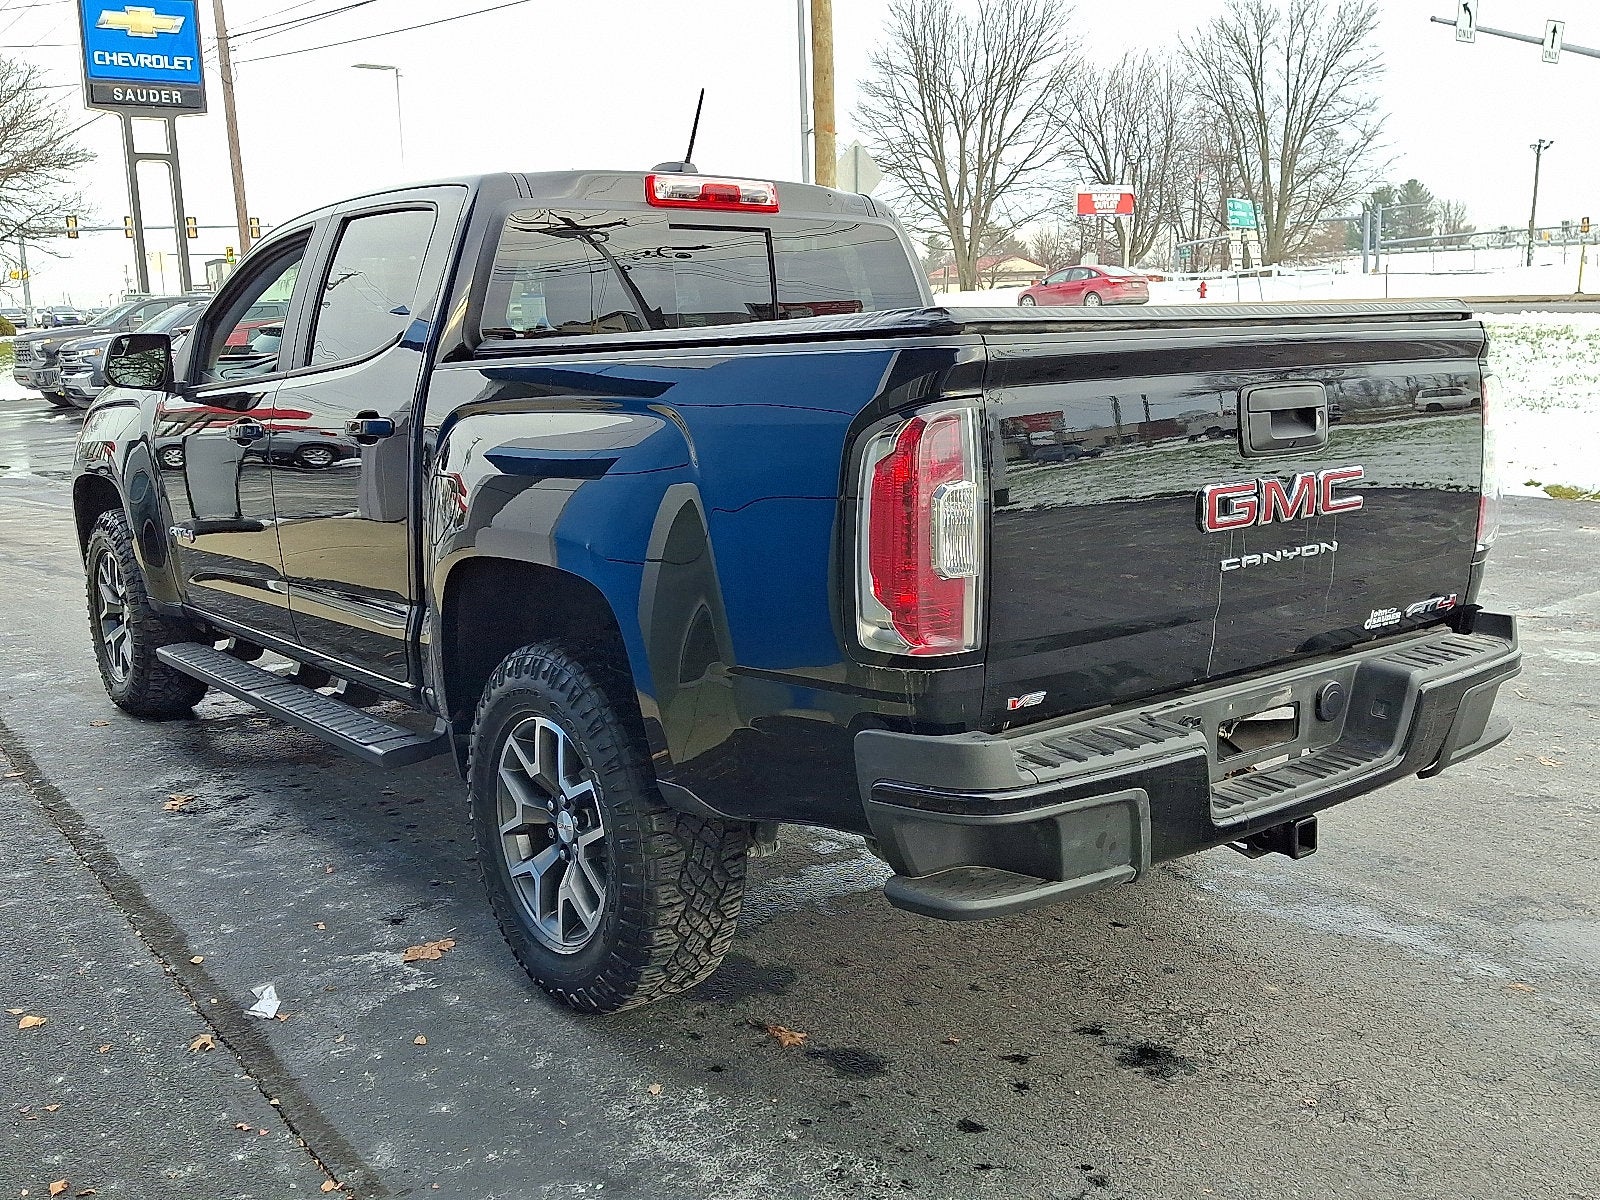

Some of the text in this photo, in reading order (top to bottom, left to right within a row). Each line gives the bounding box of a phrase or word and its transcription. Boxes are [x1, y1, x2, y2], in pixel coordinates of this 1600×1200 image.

[1458, 29, 1473, 39] ONLY
[93, 51, 193, 70] CHEVROLET
[113, 87, 182, 103] SAUDER
[1196, 465, 1364, 534] GMC
[1221, 540, 1338, 572] CANYON
